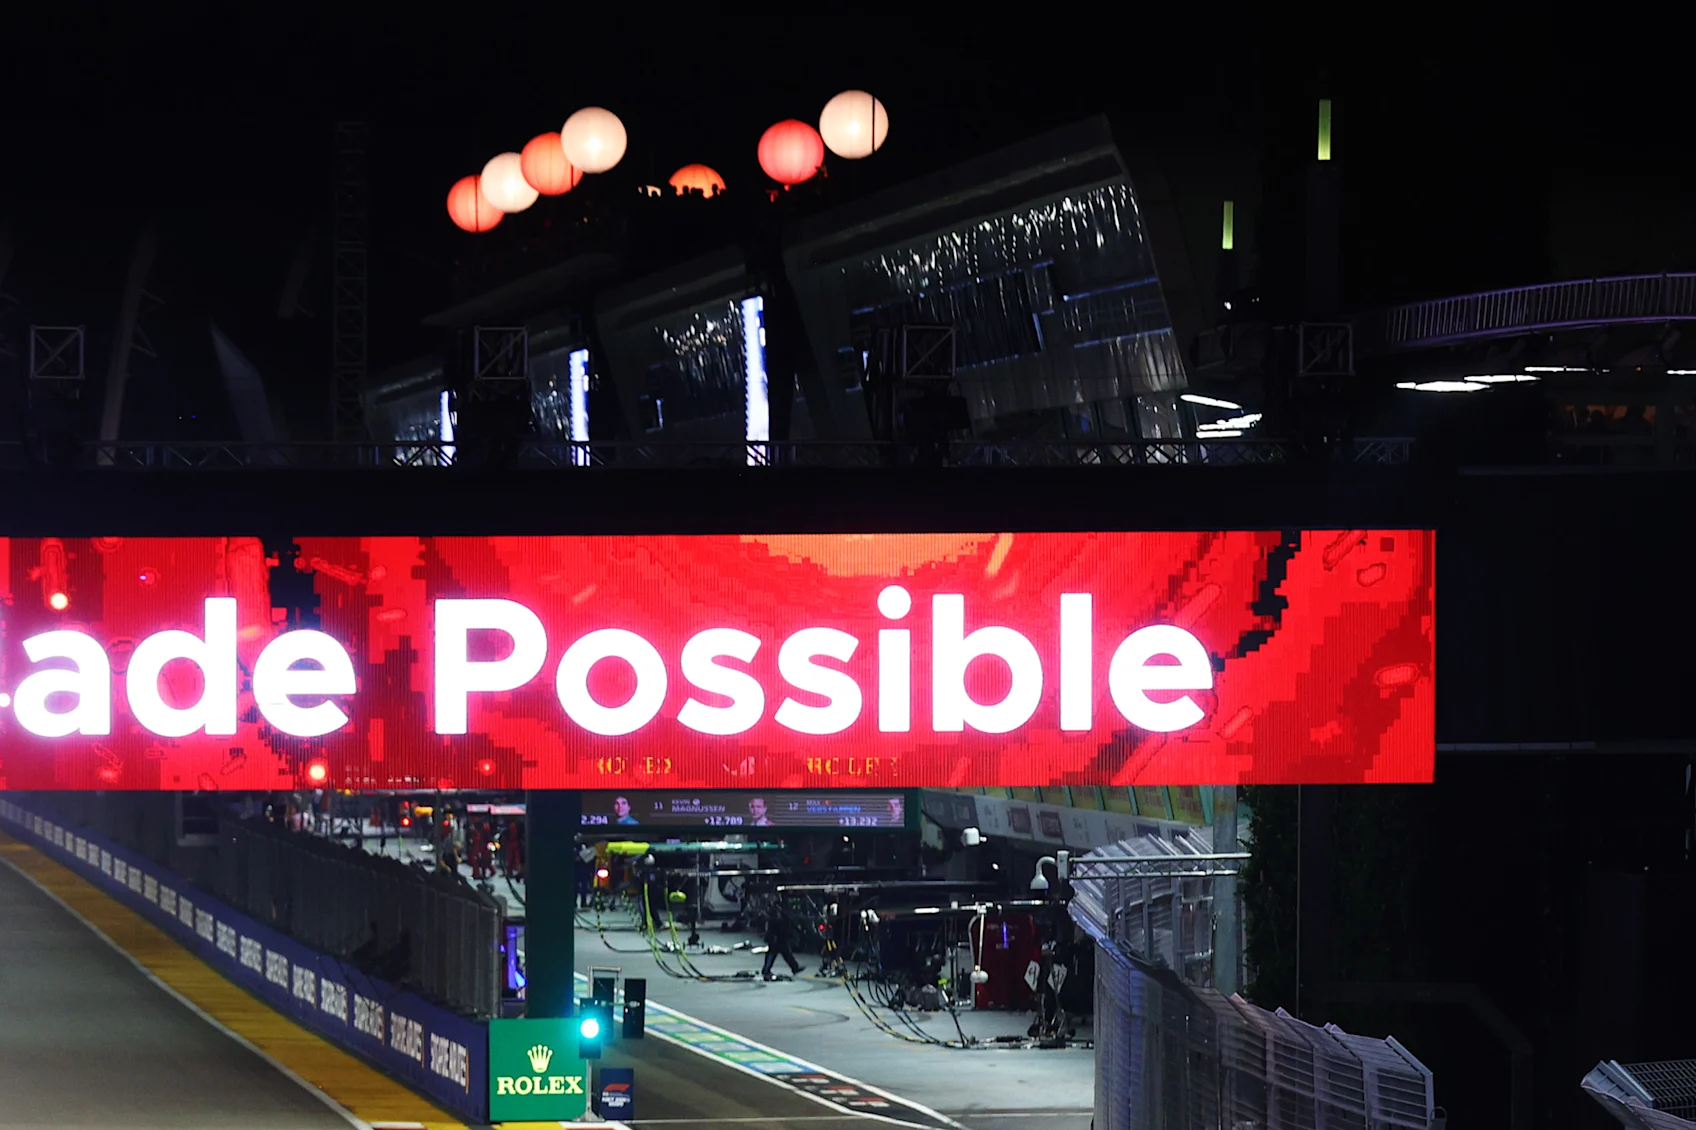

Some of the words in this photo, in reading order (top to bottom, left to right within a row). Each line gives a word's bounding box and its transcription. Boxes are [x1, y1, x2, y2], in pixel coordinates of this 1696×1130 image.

[434, 585, 1214, 736] Possible
[671, 805, 726, 813] MAGNUSSEN
[497, 1076, 584, 1095] ROLEX
